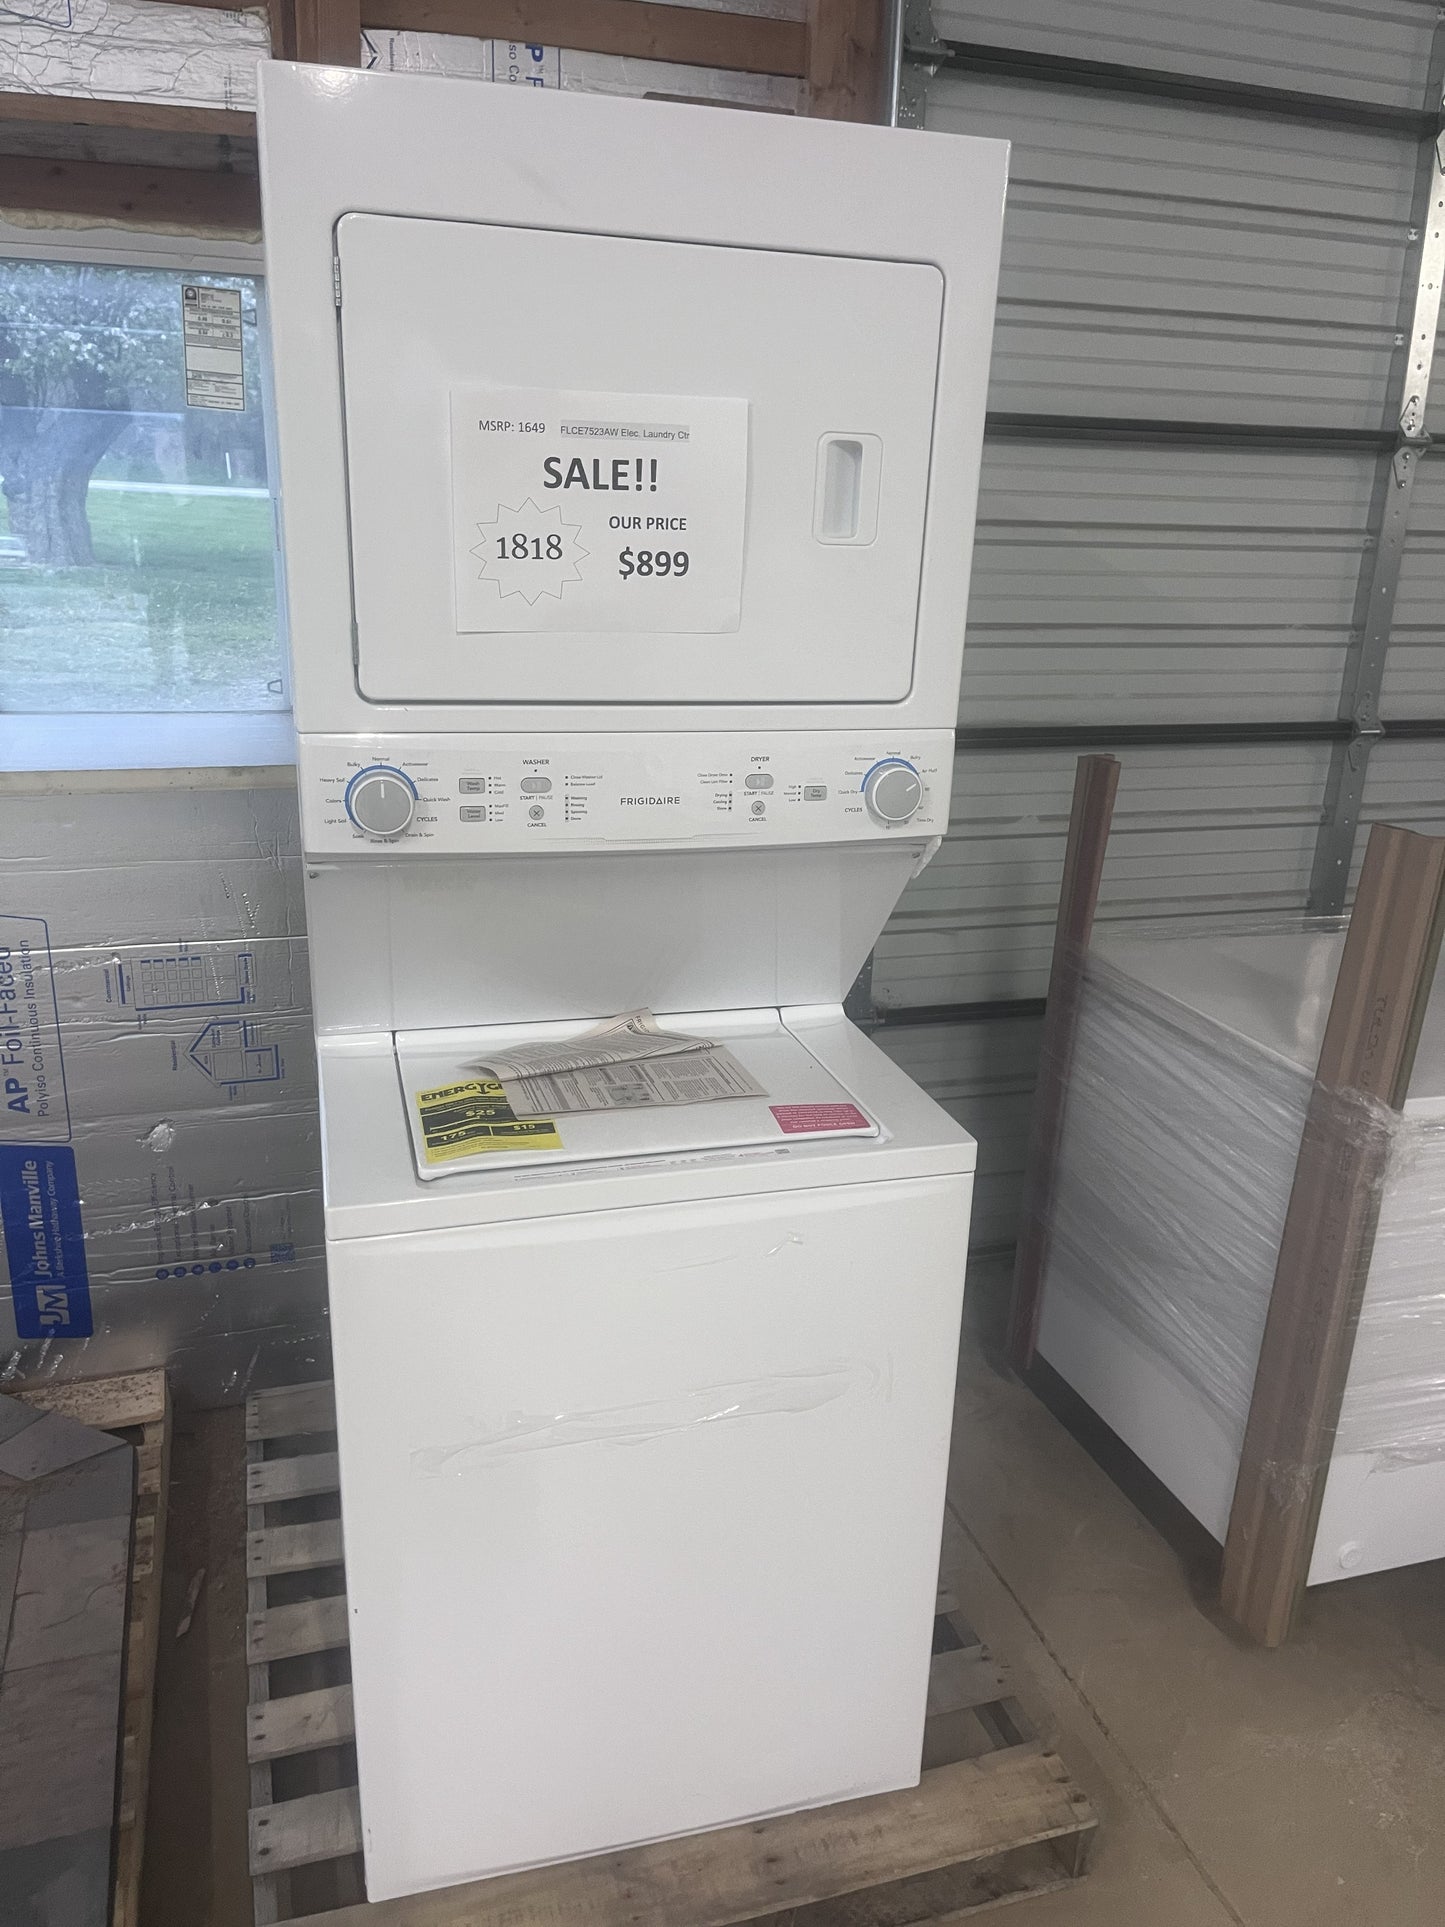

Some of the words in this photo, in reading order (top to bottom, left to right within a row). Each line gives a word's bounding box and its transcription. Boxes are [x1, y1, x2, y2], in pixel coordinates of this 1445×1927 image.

[478, 420, 515, 433] MSRP:
[518, 422, 546, 433] 1649
[560, 425, 619, 437] FLCE7523AW
[621, 428, 641, 438] Elec.
[643, 429, 675, 440] Laundry
[678, 430, 690, 440] Ctr
[543, 457, 657, 492] SALE!!
[608, 516, 642, 530] OUR
[646, 517, 688, 531] PRICE
[496, 534, 563, 560] 1818
[619, 546, 690, 580] $899
[620, 796, 680, 806] FRIGIDAIRE
[20, 939, 36, 1000] Insulation
[31, 1003, 44, 1071] Continuous
[38, 1075, 50, 1117] Polyiso
[22, 1160, 44, 1228] Manville
[46, 1160, 56, 1197] Company
[32, 1230, 52, 1278] Johns
